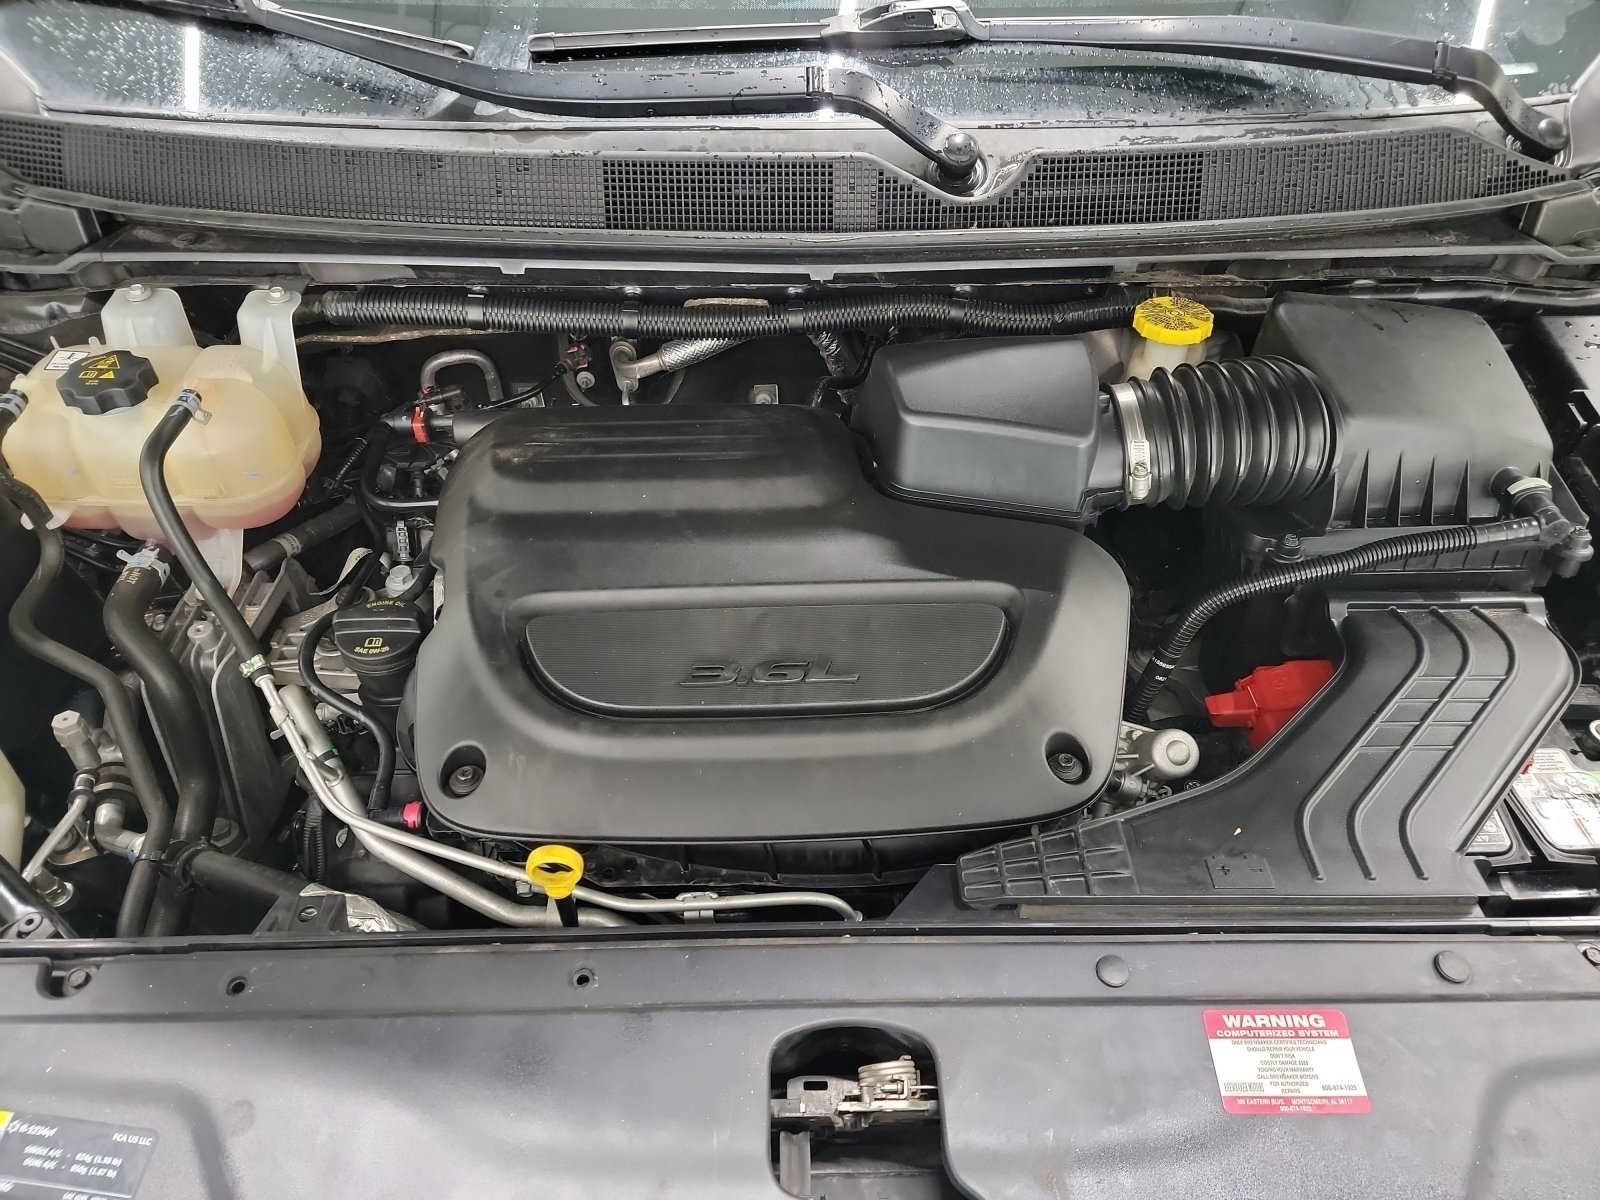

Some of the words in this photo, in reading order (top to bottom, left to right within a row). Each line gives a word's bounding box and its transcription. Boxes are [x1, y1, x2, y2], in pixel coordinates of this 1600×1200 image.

[366, 600, 394, 609] ENGINE
[354, 646, 368, 654] SAE
[679, 658, 860, 687] 3.6L
[1222, 1014, 1326, 1028] WARNING
[1216, 1029, 1295, 1038] COMPUTERIZED
[1297, 1029, 1339, 1038] SYSTEM
[112, 1133, 128, 1143] FCA
[128, 1135, 138, 1144] US
[138, 1136, 152, 1146] LLC
